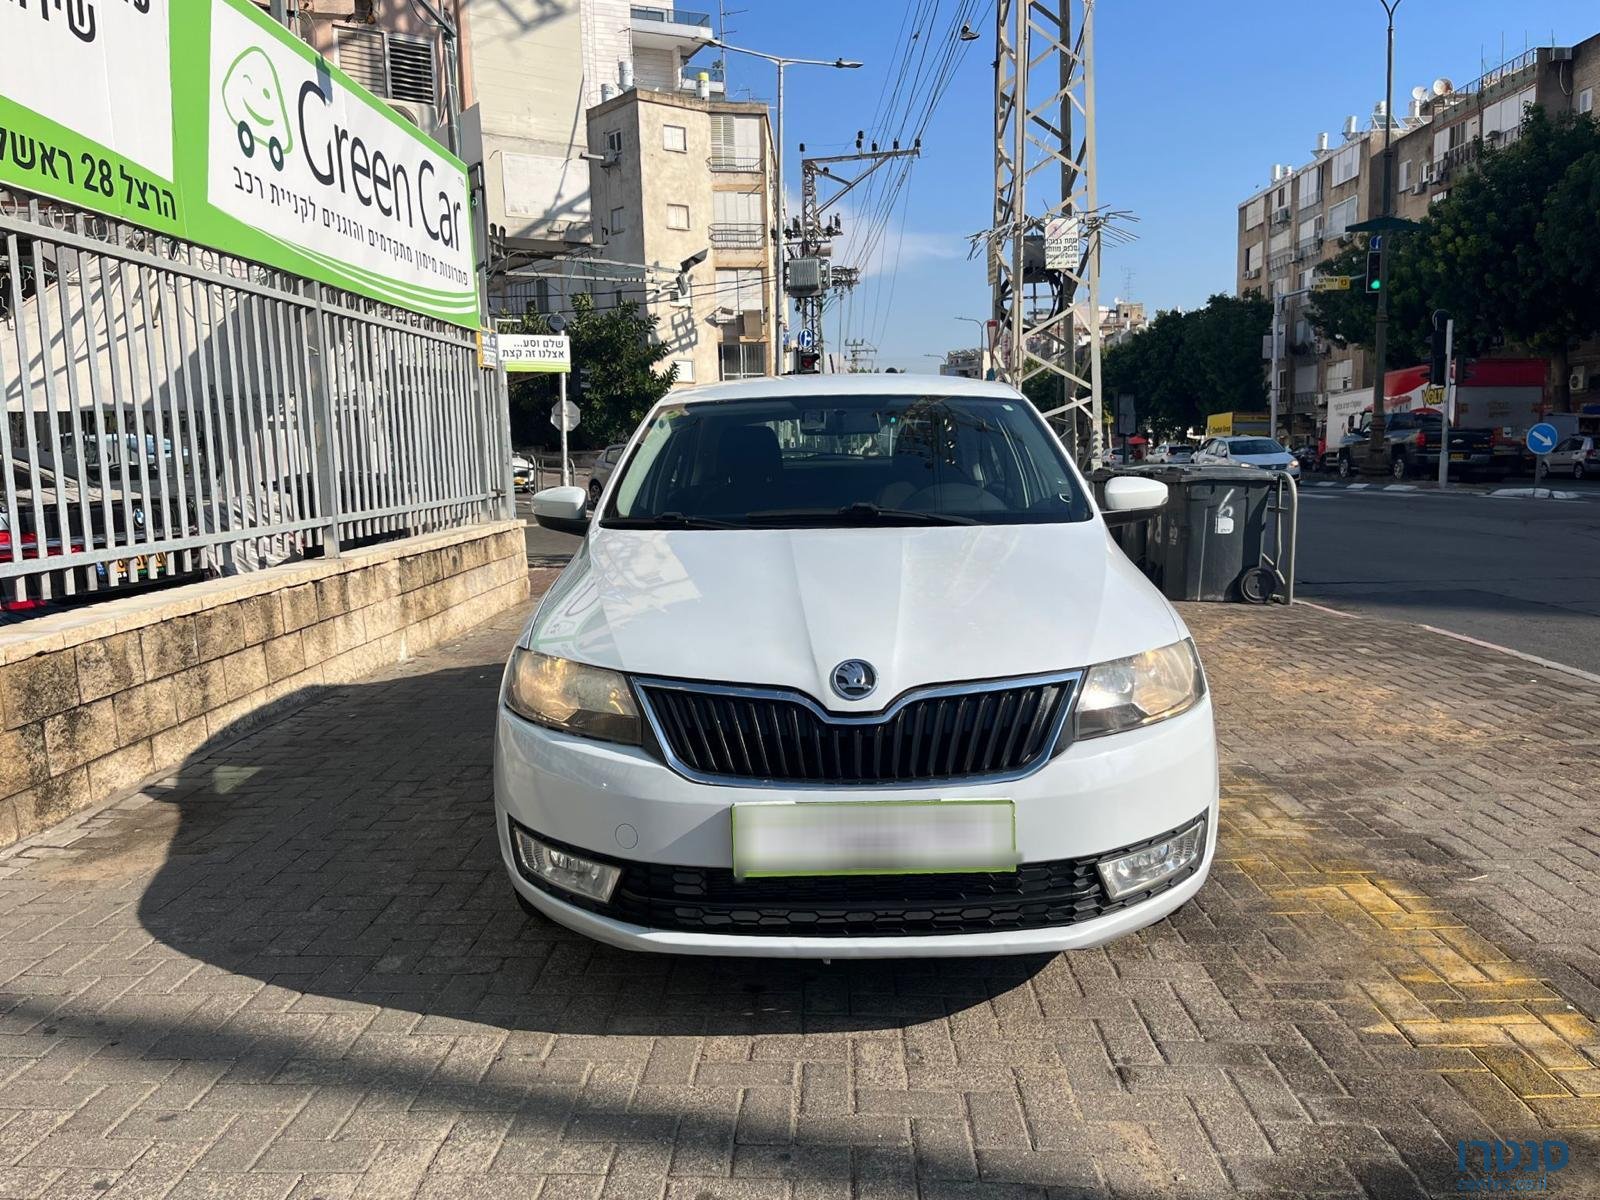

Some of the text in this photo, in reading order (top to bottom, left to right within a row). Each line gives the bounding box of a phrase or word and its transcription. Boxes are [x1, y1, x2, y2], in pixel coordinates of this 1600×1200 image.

[80, 152, 114, 198] 28
[298, 80, 462, 252] Green Car
[119, 164, 177, 221] הרצל
[233, 166, 468, 286] פתרונות מימון מתקדמים והוגנים לקניית רכב
[502, 349, 522, 359] קצת
[539, 349, 565, 358] אצלנו
[543, 339, 564, 348] שלם
